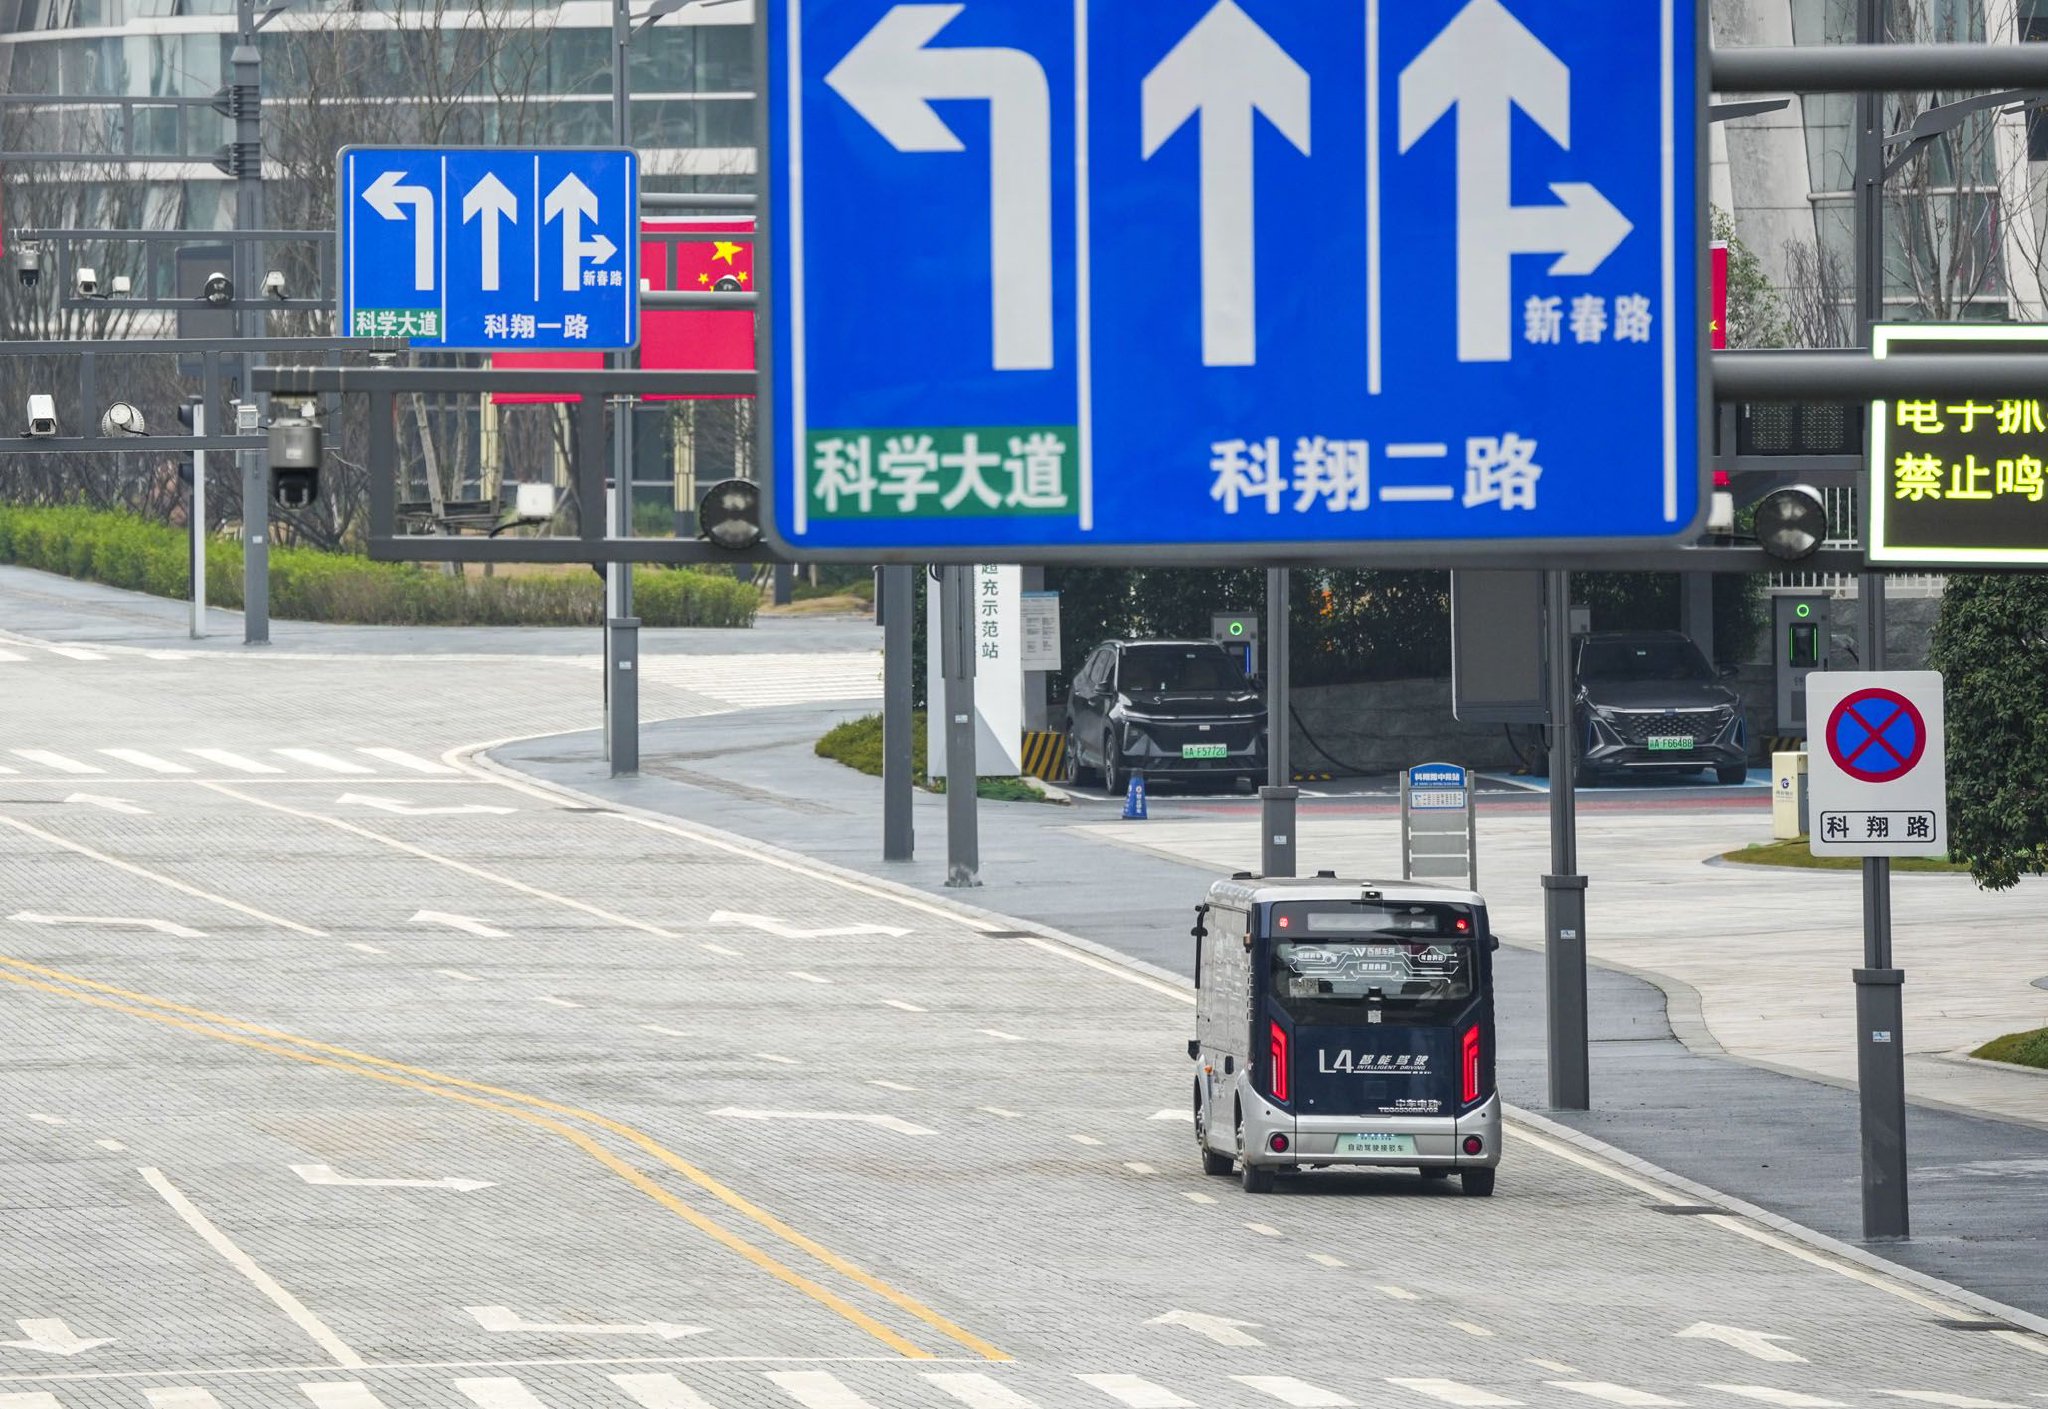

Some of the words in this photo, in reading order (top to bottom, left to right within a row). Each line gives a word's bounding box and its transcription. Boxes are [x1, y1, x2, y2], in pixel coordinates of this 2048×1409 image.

[582, 270, 623, 286] 新春路
[355, 311, 438, 336] 科学大道
[484, 314, 589, 340] 科翔一路
[1523, 294, 1653, 345] 新春路
[1896, 399, 2048, 434] 电子抓
[813, 433, 1068, 514] 科学大道
[1209, 434, 1544, 514] 科翔二路
[1895, 451, 2048, 502] 禁止鸣
[1826, 814, 1930, 839] 科翔路
[1318, 1049, 1354, 1074] L4
[1358, 1054, 1429, 1066] 智能驾驶
